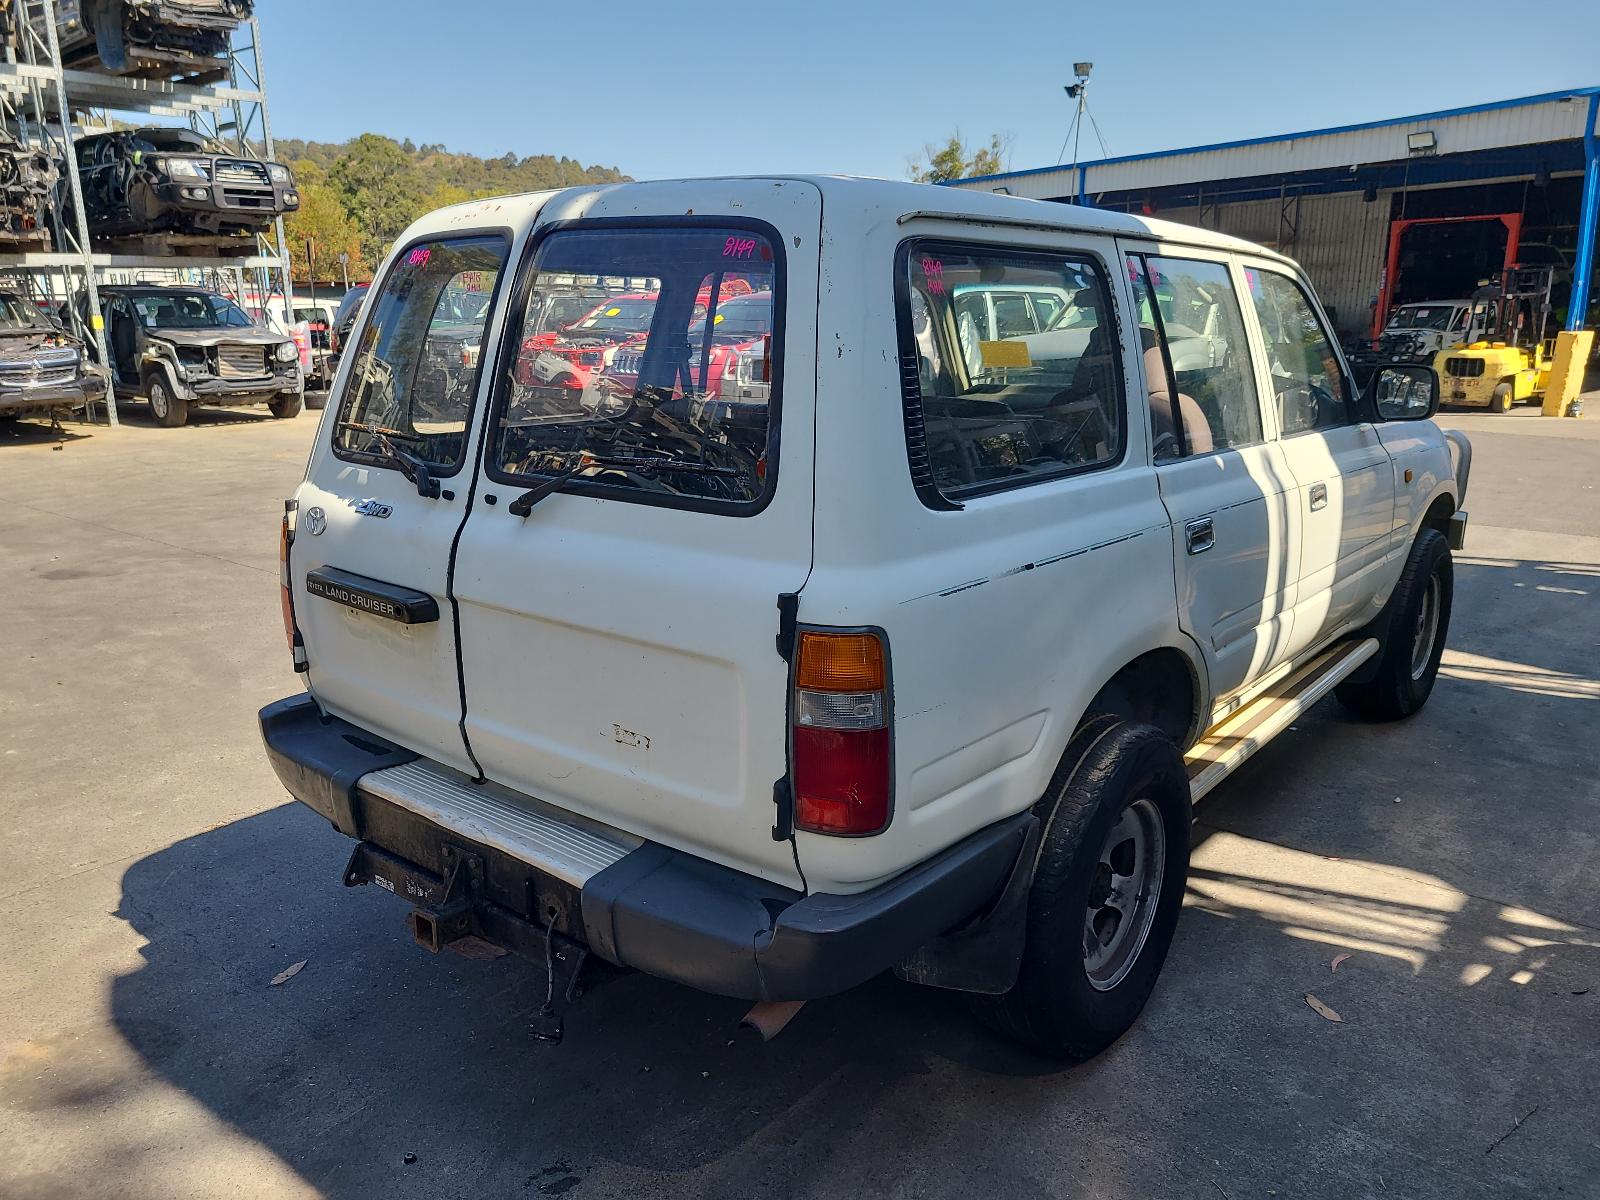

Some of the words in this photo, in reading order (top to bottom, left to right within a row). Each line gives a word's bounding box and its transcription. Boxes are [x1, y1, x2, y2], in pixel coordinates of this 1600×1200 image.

[723, 235, 756, 259] 8149
[325, 584, 349, 601] LAND
[350, 594, 395, 615] CRUISER
